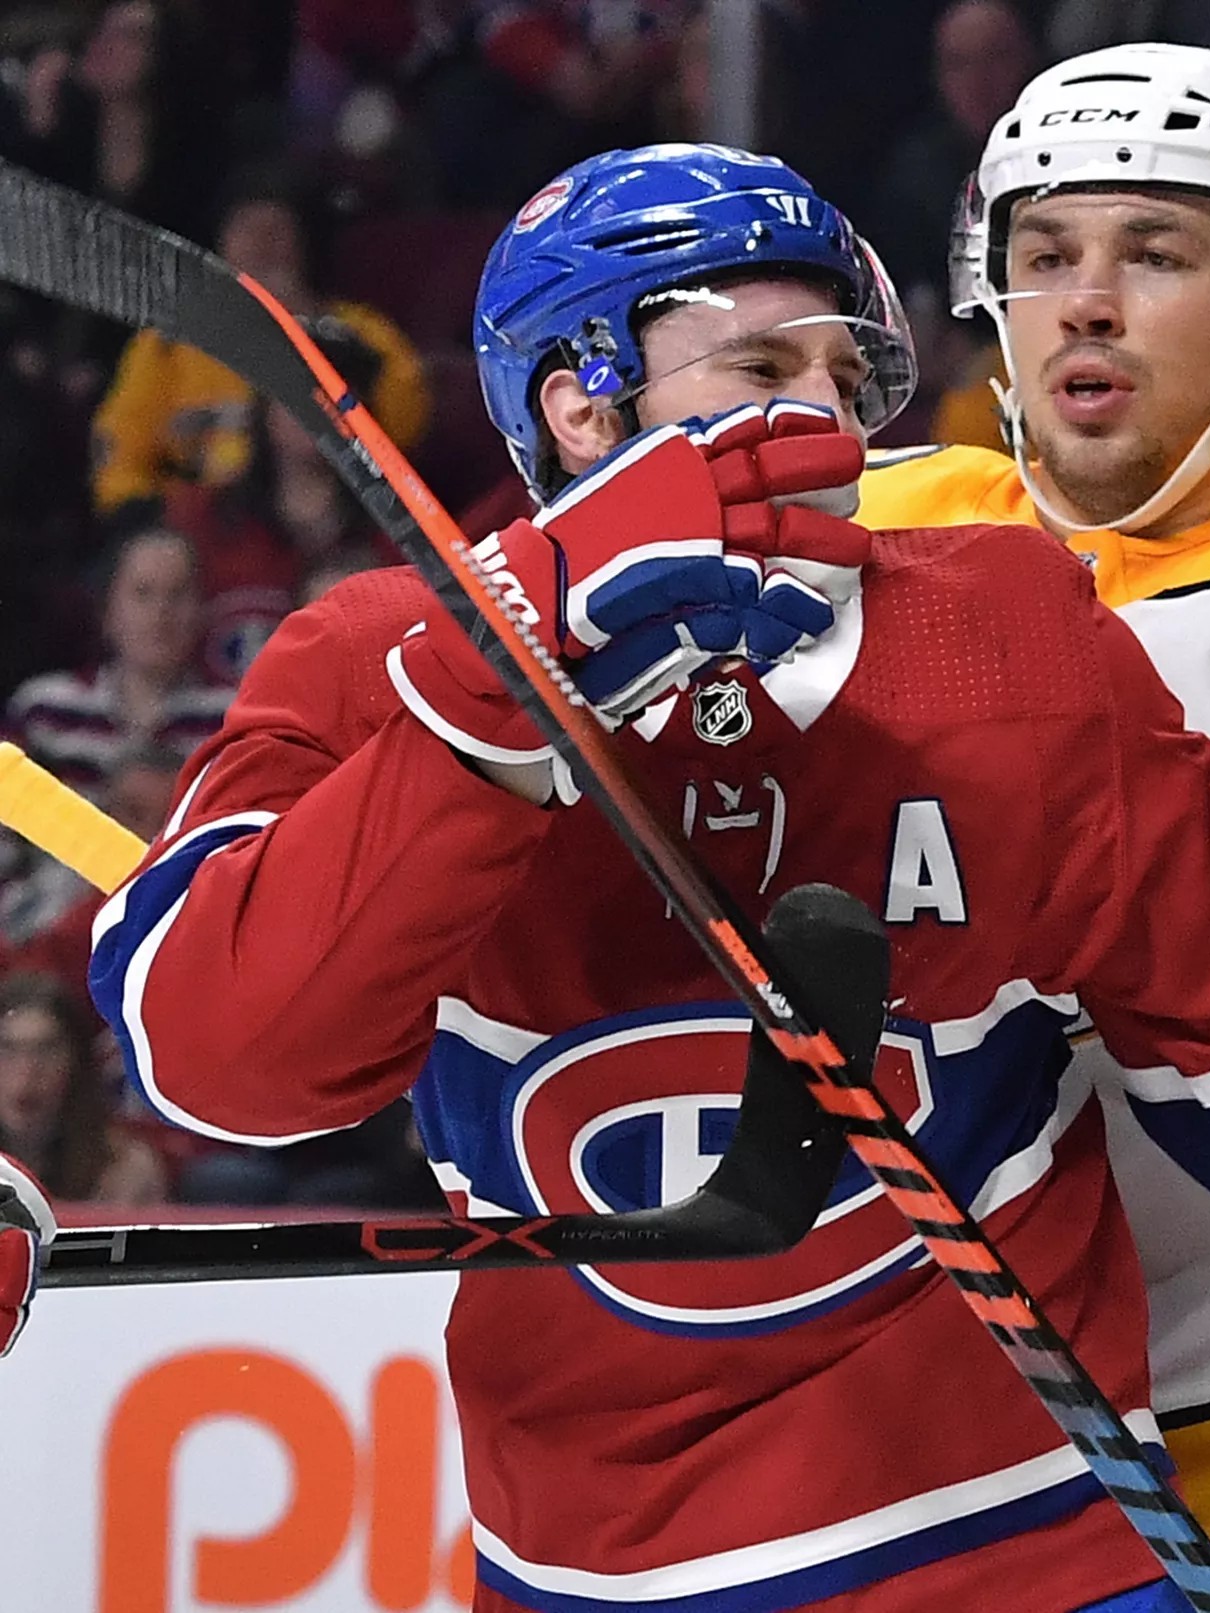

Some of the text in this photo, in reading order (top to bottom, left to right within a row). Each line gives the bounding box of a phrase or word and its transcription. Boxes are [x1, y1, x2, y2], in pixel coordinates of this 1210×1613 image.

[1038, 107, 1141, 127] CCM
[705, 694, 737, 733] LNH
[884, 798, 968, 926] A
